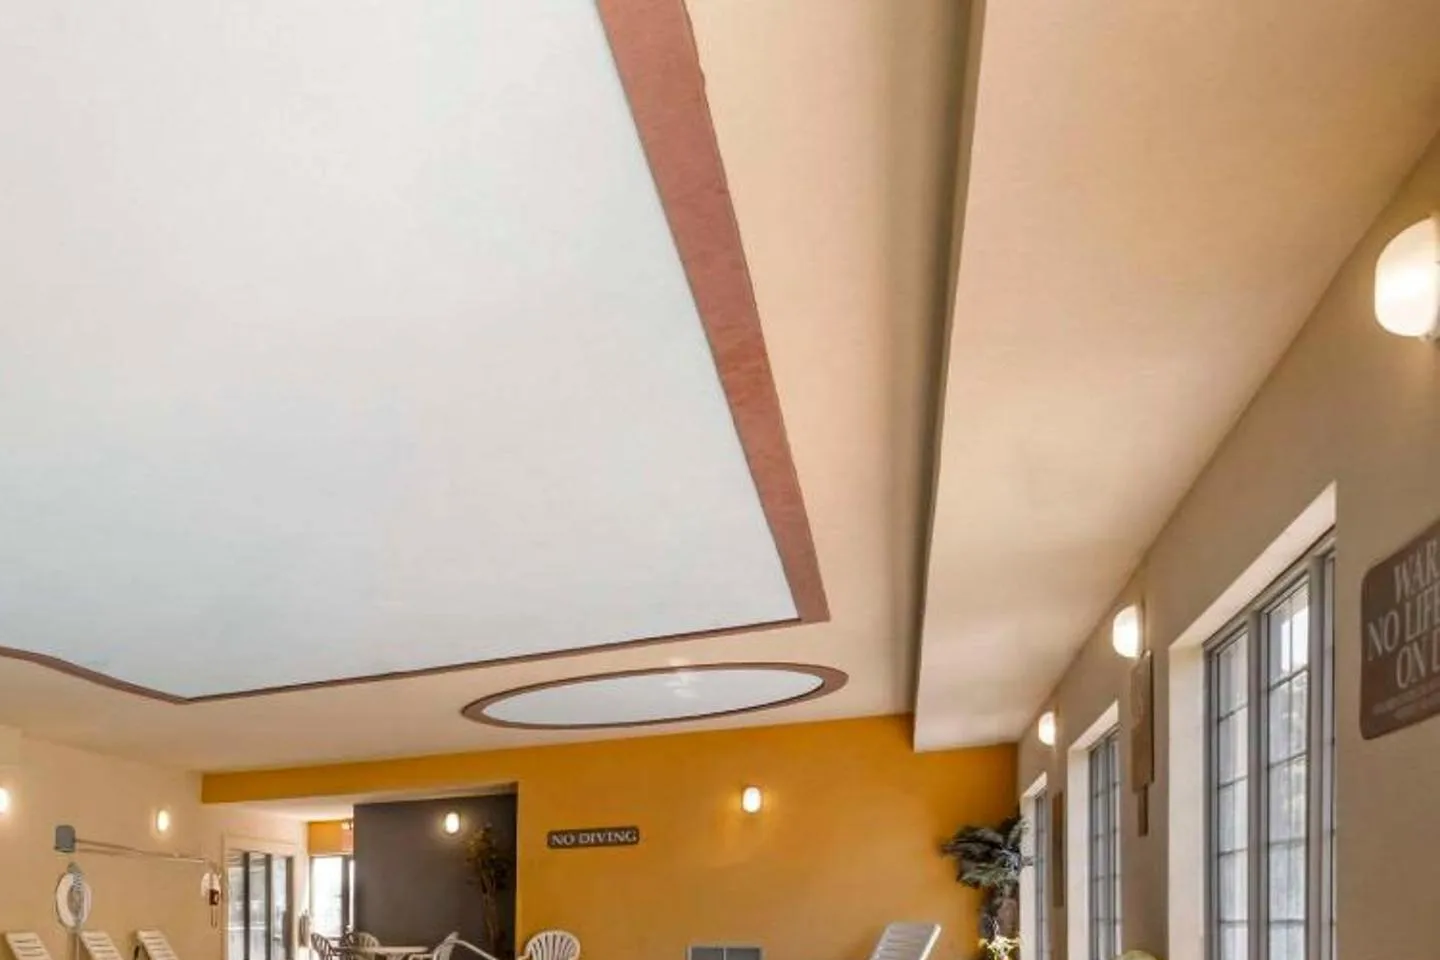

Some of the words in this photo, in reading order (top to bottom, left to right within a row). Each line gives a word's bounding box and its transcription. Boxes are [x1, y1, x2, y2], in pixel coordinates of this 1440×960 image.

[1367, 608, 1400, 661] NO
[1396, 635, 1426, 689] ON
[551, 833, 576, 846] NO
[579, 828, 637, 844] DIVING
